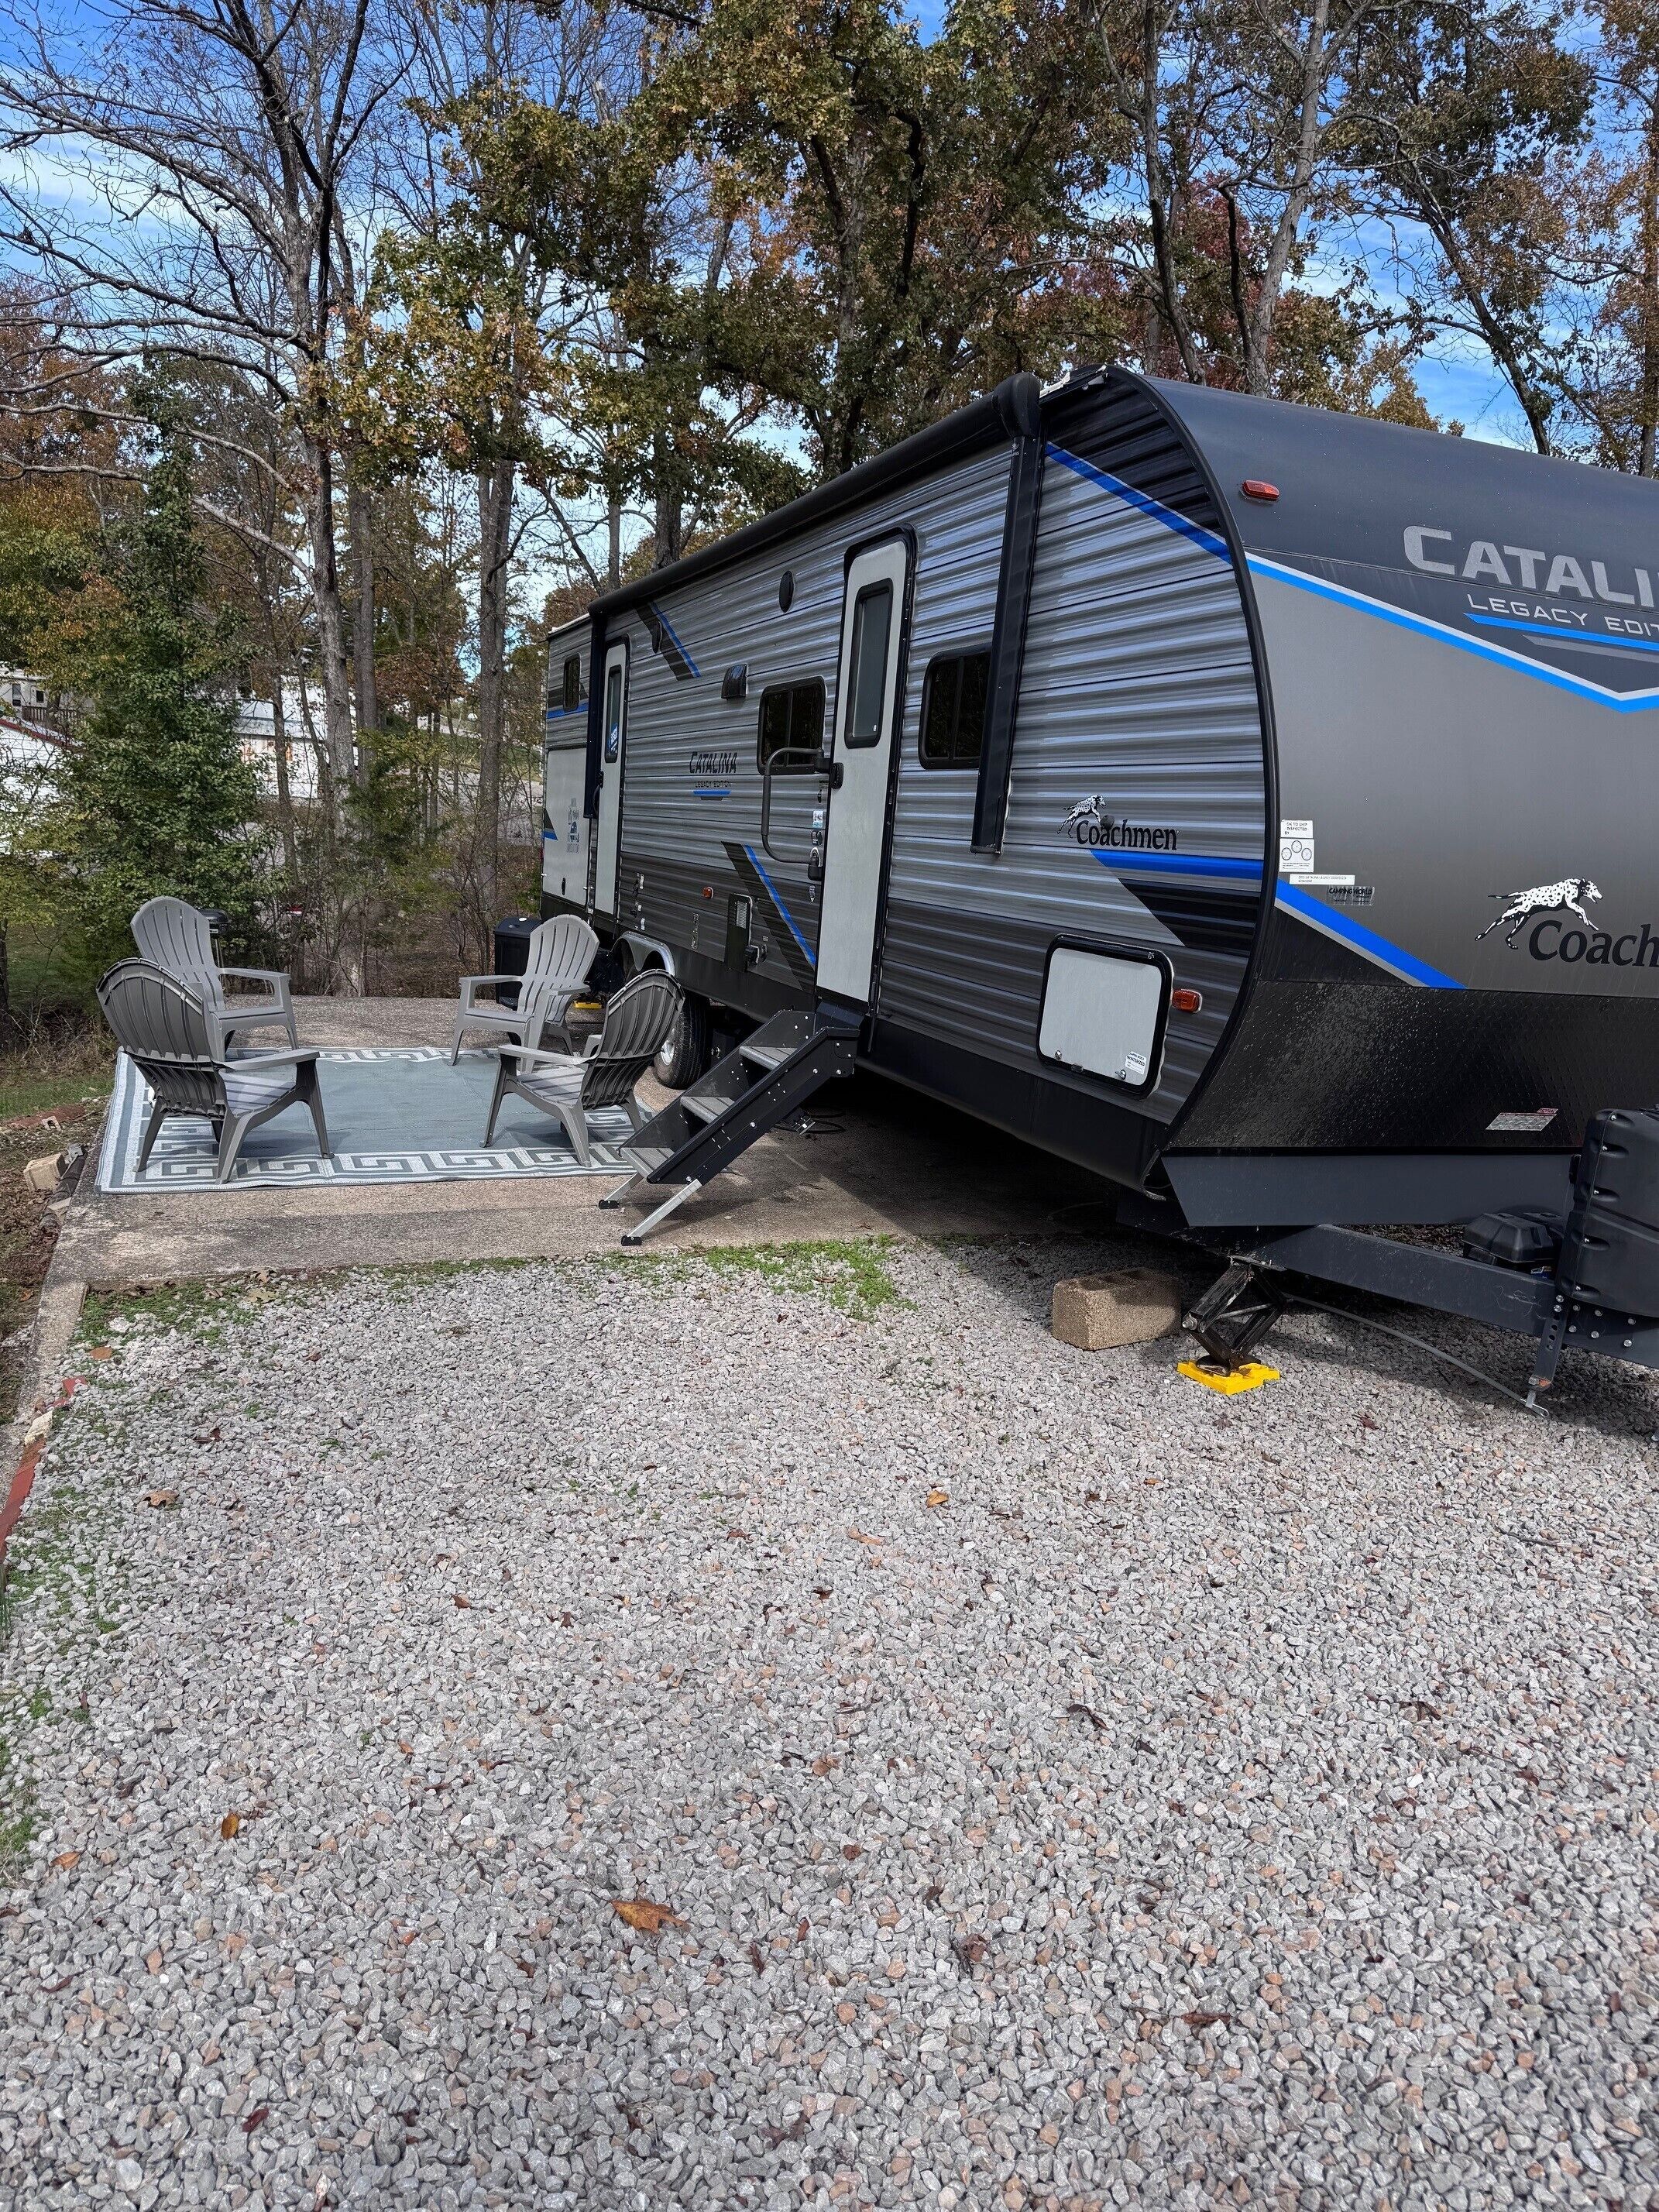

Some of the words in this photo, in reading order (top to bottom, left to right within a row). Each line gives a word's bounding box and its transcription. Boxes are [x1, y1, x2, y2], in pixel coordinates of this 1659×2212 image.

[1403, 525, 1659, 608] CATALI
[1467, 594, 1588, 626] LEGACY
[689, 751, 737, 774] CATALINA
[1076, 819, 1177, 850] Coachmen
[1529, 919, 1659, 967] Coach
